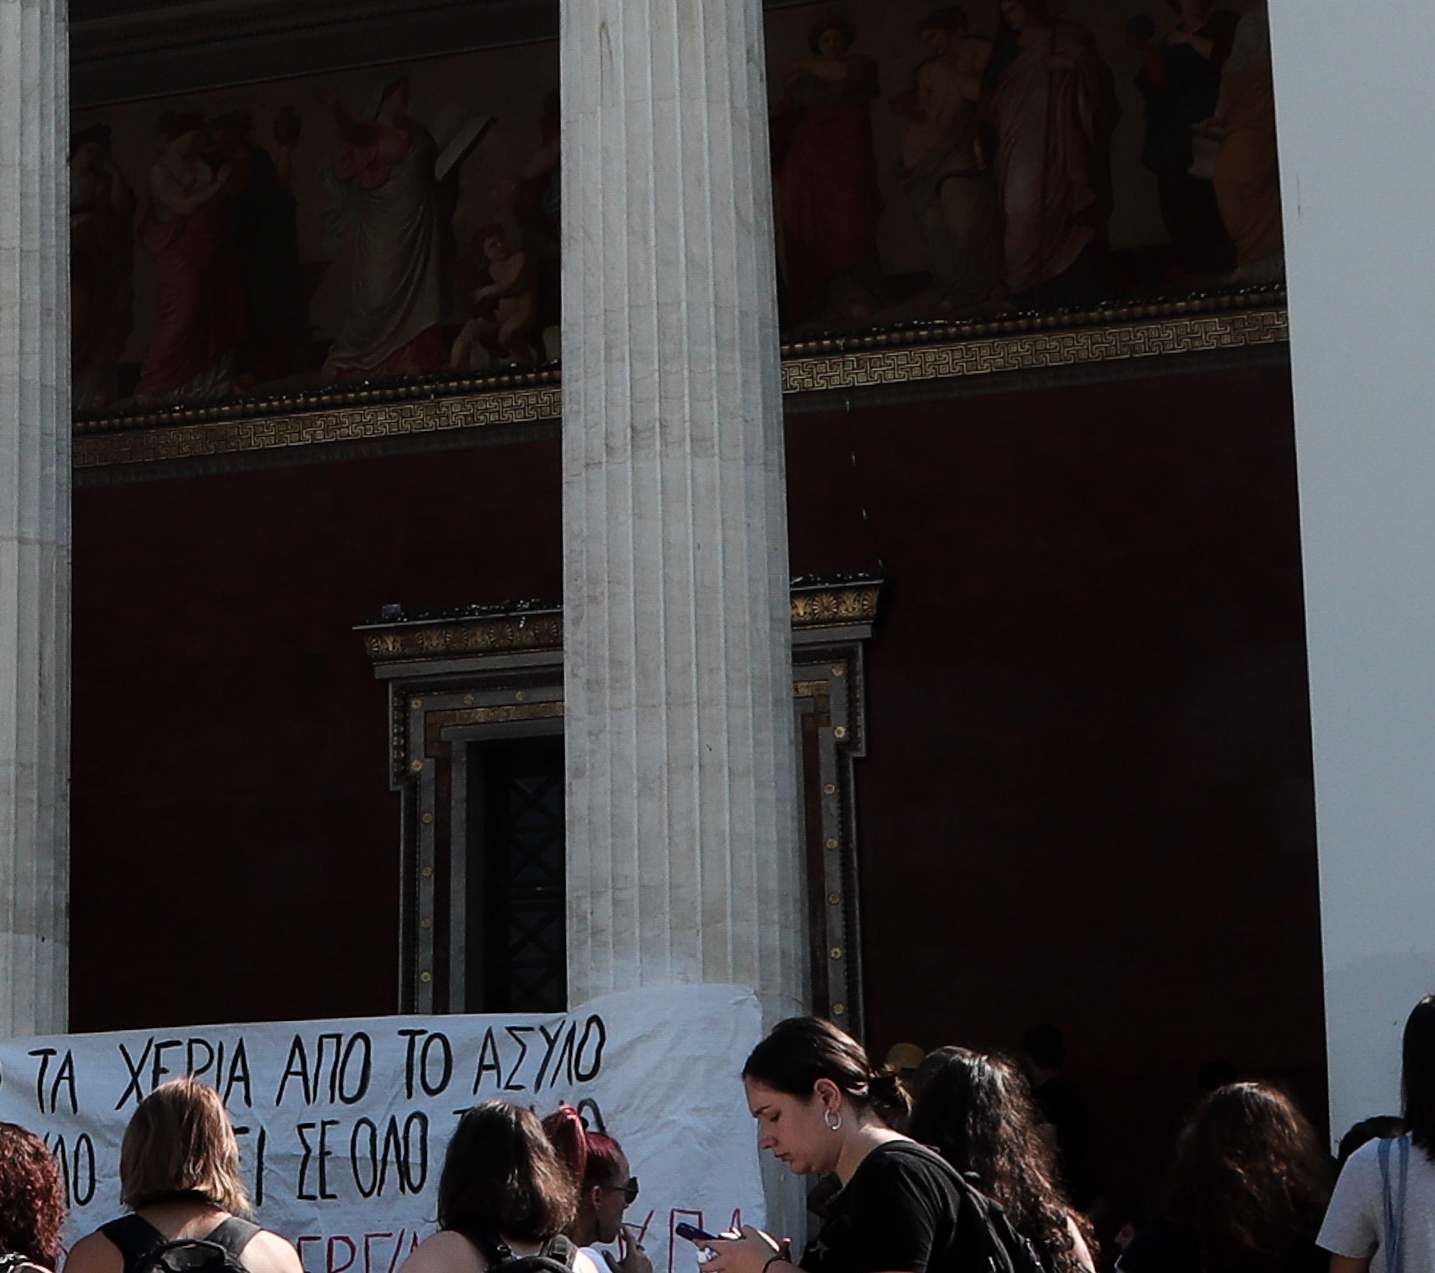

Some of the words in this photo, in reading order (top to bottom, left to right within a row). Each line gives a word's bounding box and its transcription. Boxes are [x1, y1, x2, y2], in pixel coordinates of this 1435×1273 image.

[27, 1047, 79, 1116] ΤΑ
[114, 1035, 253, 1112] ΧΕΡΙΑ
[275, 1031, 373, 1107] ΑΠΟ
[397, 1029, 454, 1100] ΤΟ
[472, 1014, 606, 1096] ΑΣΥΛΟ
